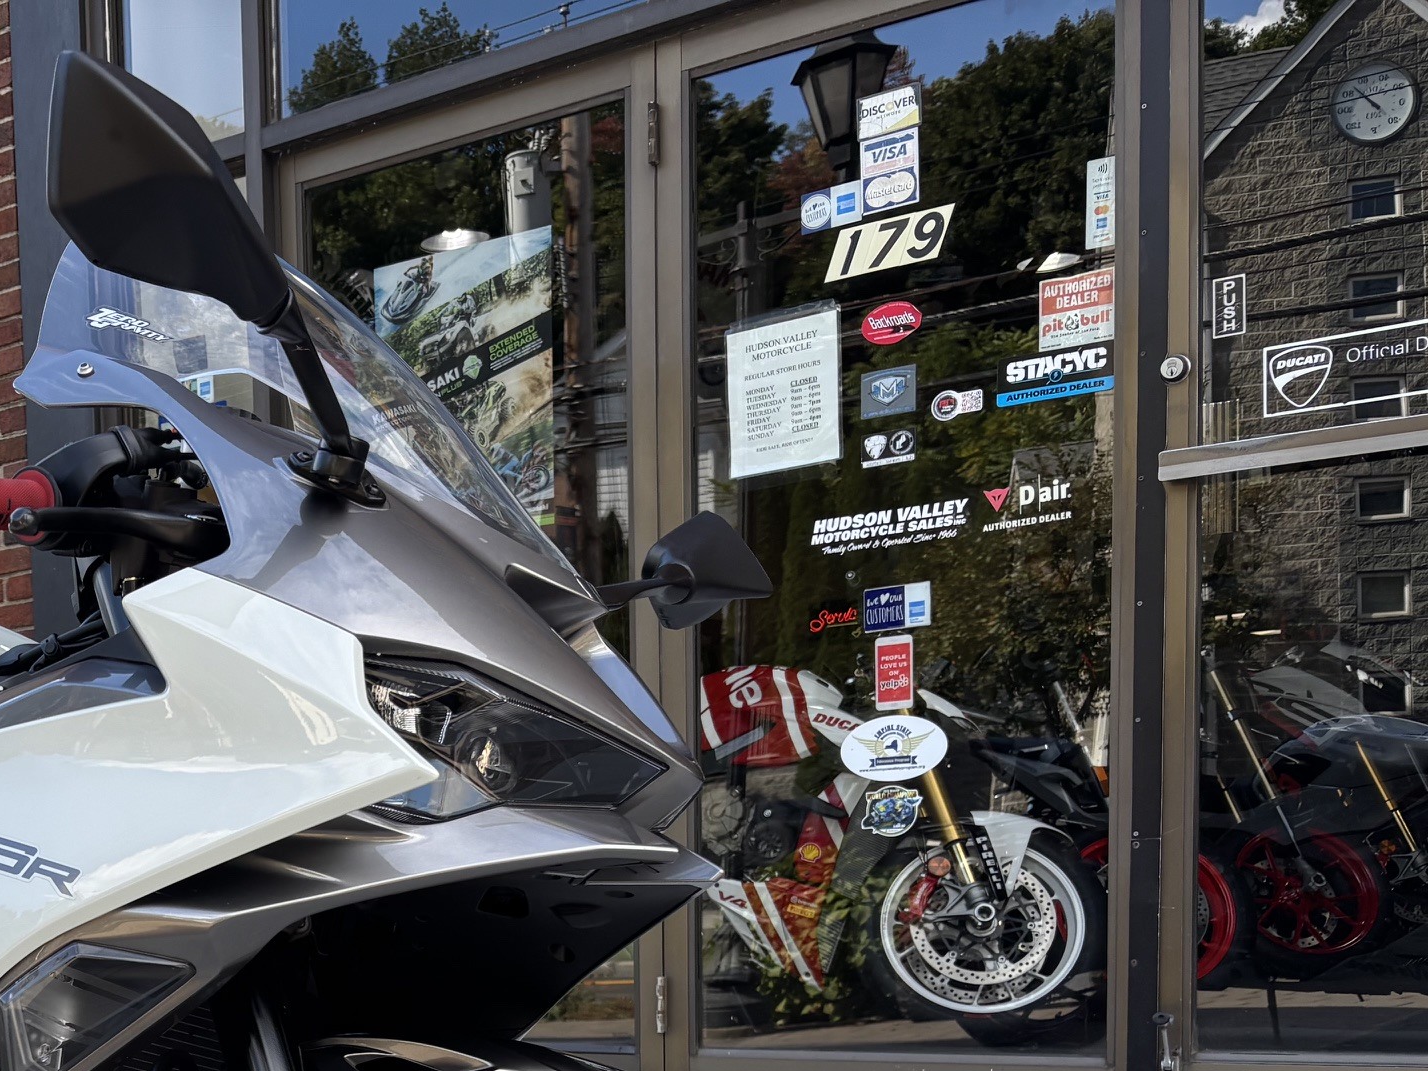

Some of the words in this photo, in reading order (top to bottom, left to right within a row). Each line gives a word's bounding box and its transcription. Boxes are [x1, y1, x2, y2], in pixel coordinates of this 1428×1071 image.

[861, 95, 915, 118] DISCOVER
[871, 144, 907, 163] VISA
[840, 212, 945, 276] 179
[1044, 274, 1112, 299] AUTHORIZED
[1056, 291, 1098, 309] DEALER
[1223, 281, 1236, 331] PUSH
[87, 307, 150, 328] ZERO
[868, 311, 916, 330] Backroads
[1042, 318, 1064, 337] pit
[1080, 310, 1110, 326] bull
[90, 320, 173, 342] GRAVITY
[488, 325, 536, 354] EXTENDED
[745, 338, 781, 353] HUDSON
[782, 330, 818, 343] VALLEY
[489, 332, 539, 361] COVERAGE
[752, 342, 812, 361] MOTORCYCLE
[1347, 339, 1409, 362] Official
[744, 370, 775, 382] REGULAR
[776, 365, 797, 375] STORE
[798, 360, 821, 370] HOURS
[1006, 347, 1107, 383] STACYC
[1276, 353, 1325, 370] DUCATI
[426, 367, 460, 392] SAKI
[745, 385, 775, 396] MONDAY
[790, 376, 818, 388] CLOSED
[746, 392, 777, 404] TUESDAY
[1006, 386, 1067, 402] AUTHORIZED
[1069, 380, 1105, 391] DEALER
[746, 397, 787, 411] WEDNESDAY
[747, 406, 781, 419] THURSDAY
[747, 416, 771, 427] FRIDAY
[747, 421, 782, 434] SATURDAY
[747, 430, 775, 441] SUNDAY
[791, 422, 819, 433] CLOSED
[813, 510, 893, 534] HUDSON
[896, 498, 970, 521] VALLEY
[982, 517, 1037, 533] AUTHORIZED
[1039, 511, 1072, 524] DEALER
[811, 523, 906, 546] MOTORCYCLE
[907, 517, 953, 532] SALES
[953, 517, 966, 526] INC
[821, 543, 847, 556] Family
[881, 534, 912, 549] Operated
[937, 529, 958, 540] 1966
[866, 605, 904, 625] CUSTOMERS
[880, 680, 901, 690] yelp
[812, 713, 860, 731] DUCA
[975, 836, 1002, 890] PIRELLI
[719, 891, 747, 908] V4
